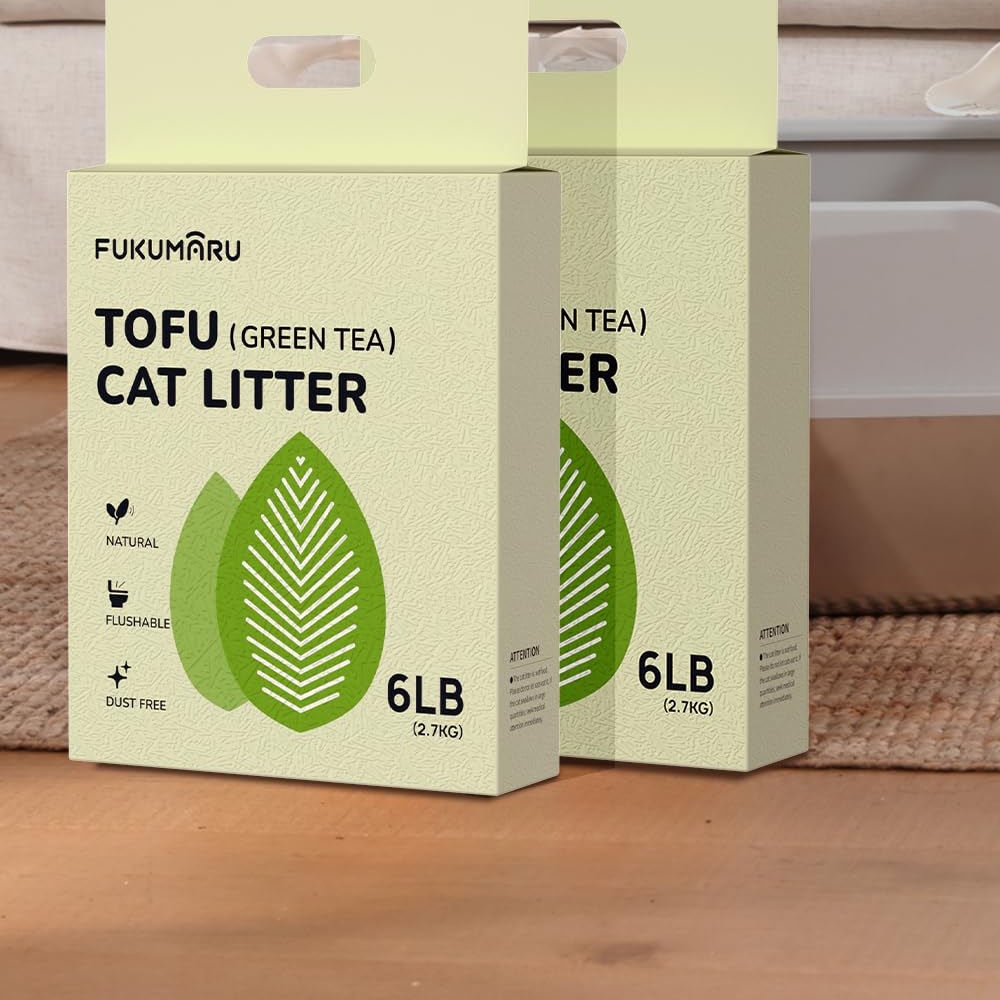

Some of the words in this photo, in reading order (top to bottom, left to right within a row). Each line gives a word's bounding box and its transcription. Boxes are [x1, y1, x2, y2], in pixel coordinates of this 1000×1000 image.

[94, 231, 241, 261] FUKUMARU
[95, 308, 218, 350] TOFU
[230, 323, 326, 351] (GREEN
[333, 326, 396, 355] TEA)
[585, 308, 647, 336] TEA)
[97, 365, 187, 407] CAT
[203, 368, 367, 413] LITTER
[106, 535, 160, 549] NATURAL
[106, 614, 171, 630] FLUSHABLE
[758, 623, 790, 641] ATTENTION
[509, 645, 540, 663] ATTENTION
[638, 650, 714, 693] 6LB
[106, 695, 137, 709] DUST
[139, 698, 167, 711] FREE
[387, 673, 464, 716] 6LB
[663, 697, 714, 717] (2.7KG)
[412, 721, 463, 740] (2.7KG)
